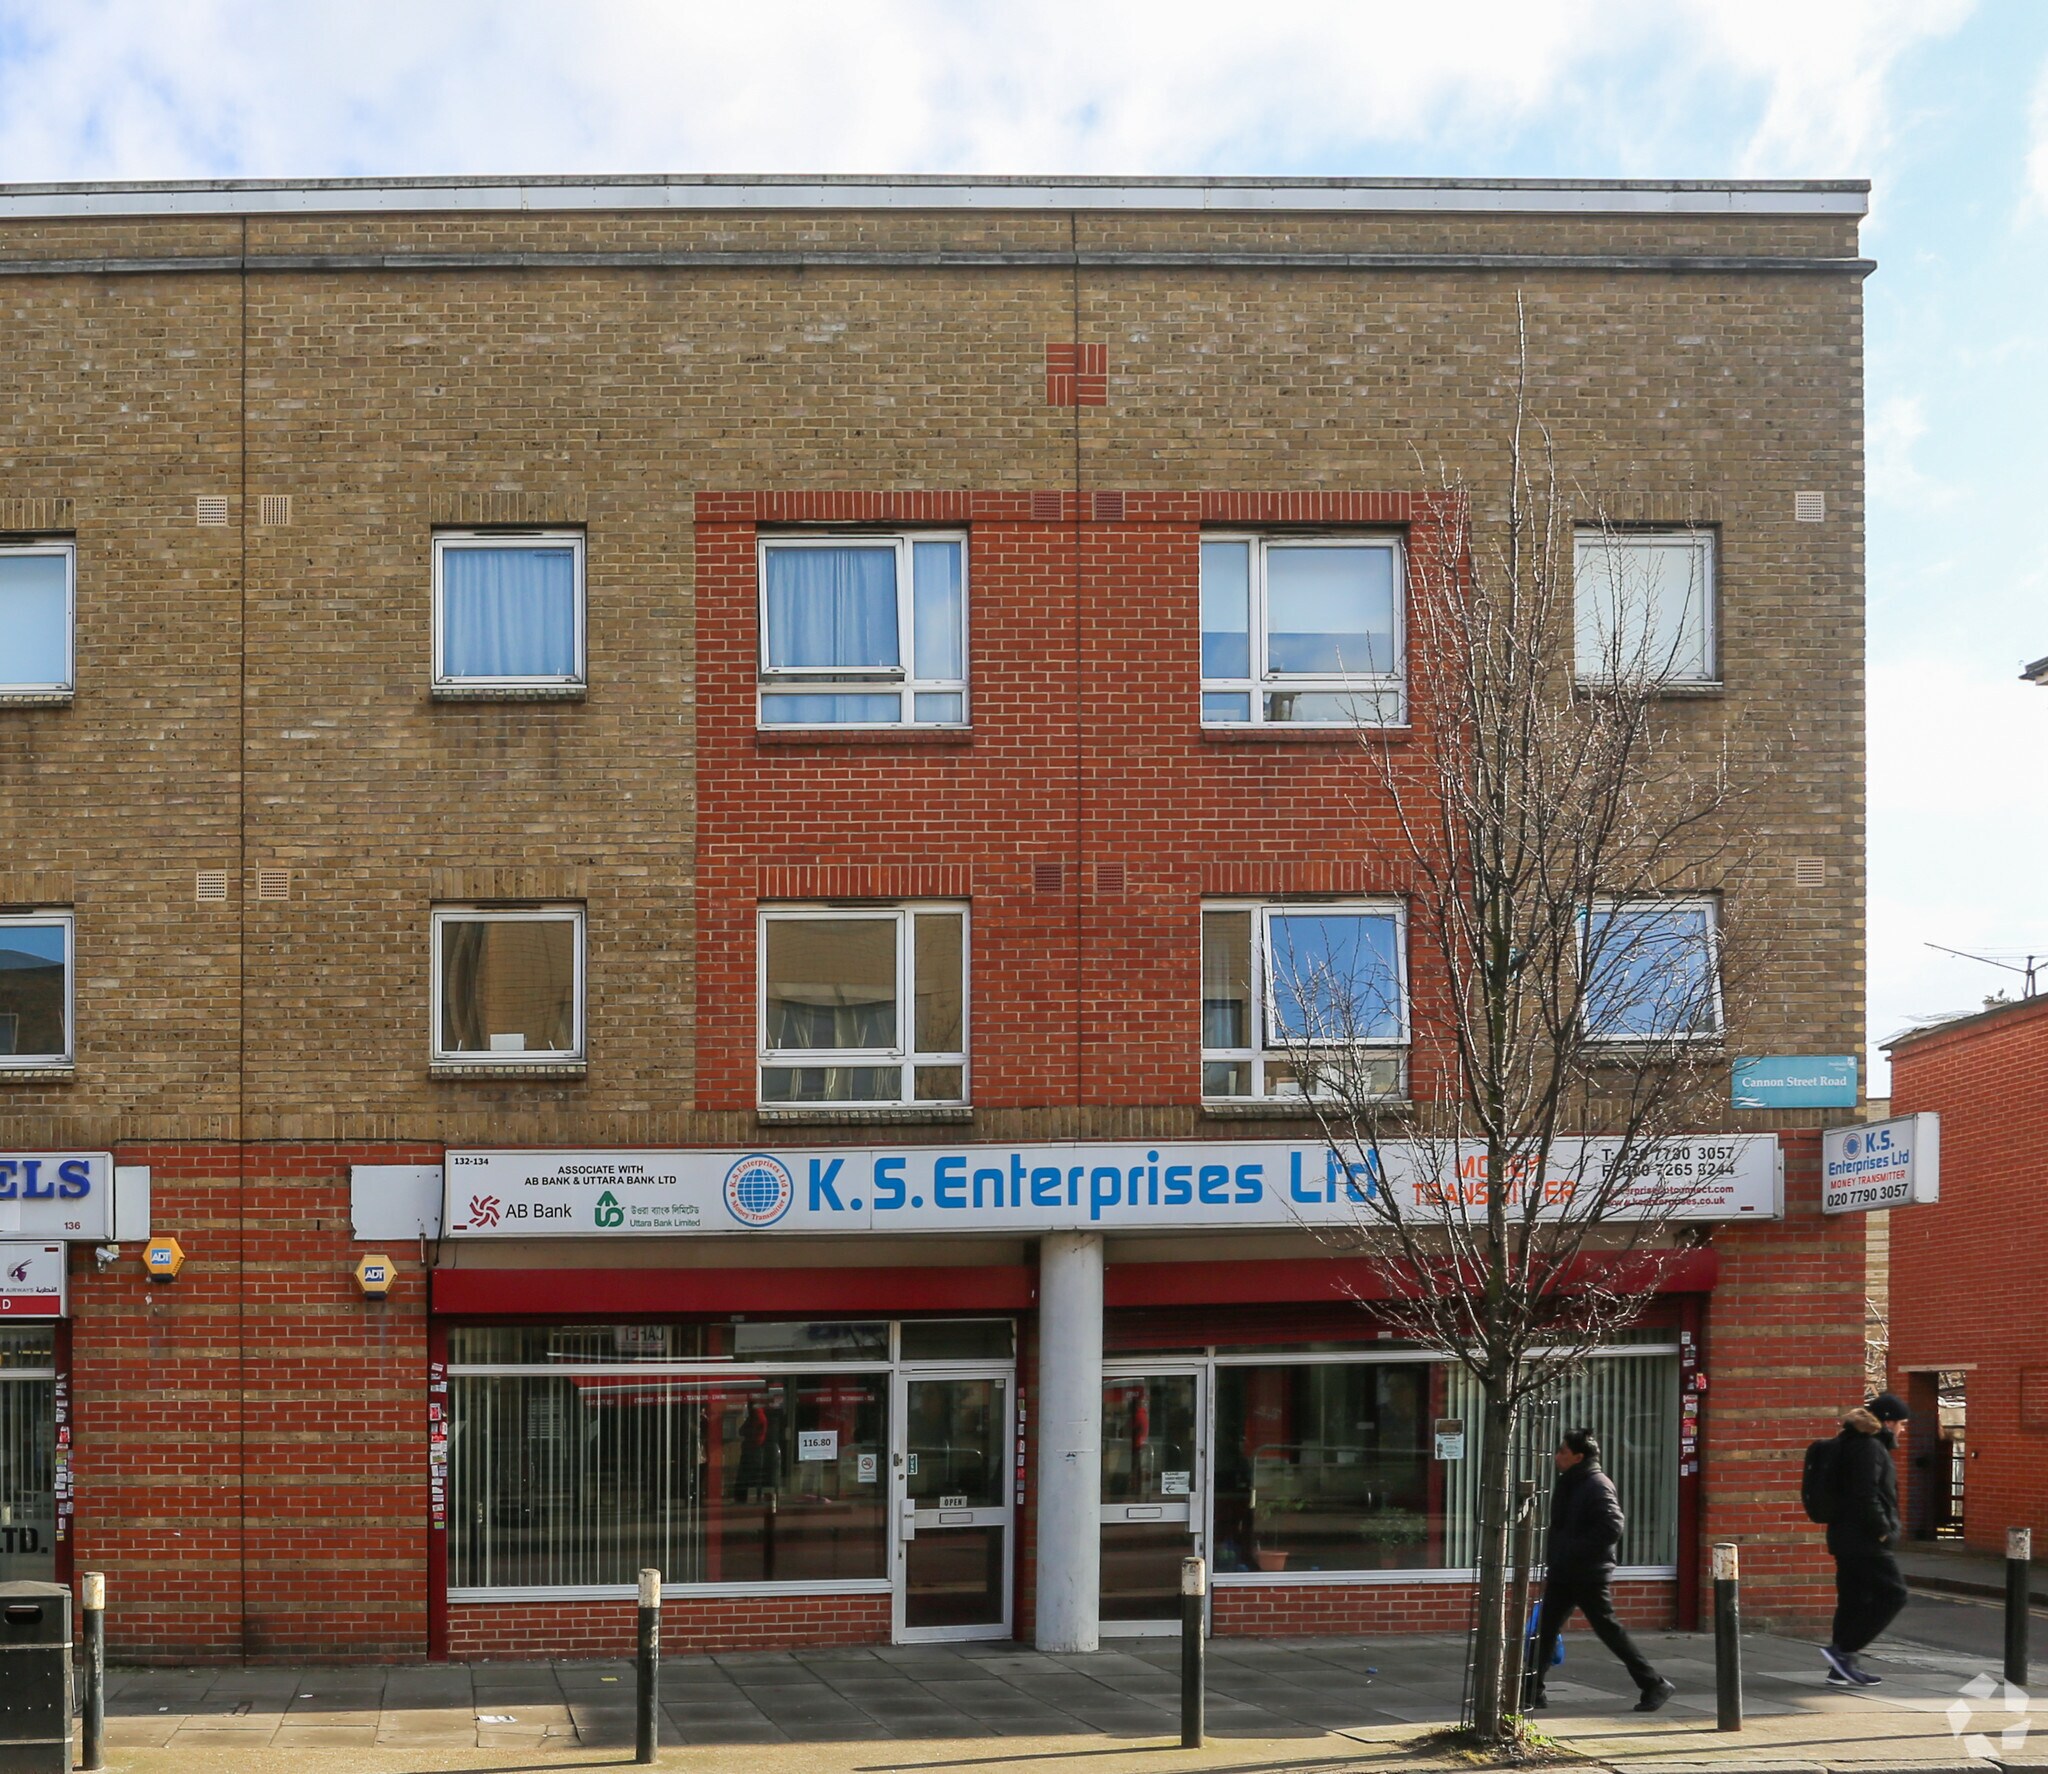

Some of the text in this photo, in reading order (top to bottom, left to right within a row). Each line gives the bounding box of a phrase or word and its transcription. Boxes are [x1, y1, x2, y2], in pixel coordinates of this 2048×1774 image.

[1742, 1076, 1847, 1087] Cannon Street Road
[1866, 1129, 1894, 1153] K.S.
[1698, 1147, 1735, 1160] 3057
[454, 1157, 489, 1165] 132-134
[1455, 1155, 1541, 1178] MOEY
[1829, 1149, 1909, 1176] Enterprises Ltd
[558, 1165, 644, 1174] ASSOCIATE WITH
[1290, 1148, 1377, 1203] Ltd
[524, 1175, 677, 1185] AB BANK & UTTARA BANK LTD
[778, 1173, 789, 1188] Ltd
[1830, 1170, 1906, 1189] MONEY TRANSMITTER
[1412, 1181, 1576, 1206] TRANSIER
[1827, 1183, 1908, 1207] 020 7790 3057
[505, 1203, 572, 1218] AB Bank
[731, 1199, 785, 1220] Money Transmitter
[64, 1222, 81, 1230] 136
[630, 1218, 700, 1227] Uttara Bank Limited
[151, 1252, 171, 1263] ADT
[365, 1268, 385, 1280] ADT
[803, 1439, 831, 1447] 116.80
[944, 1497, 962, 1506] OPEN
